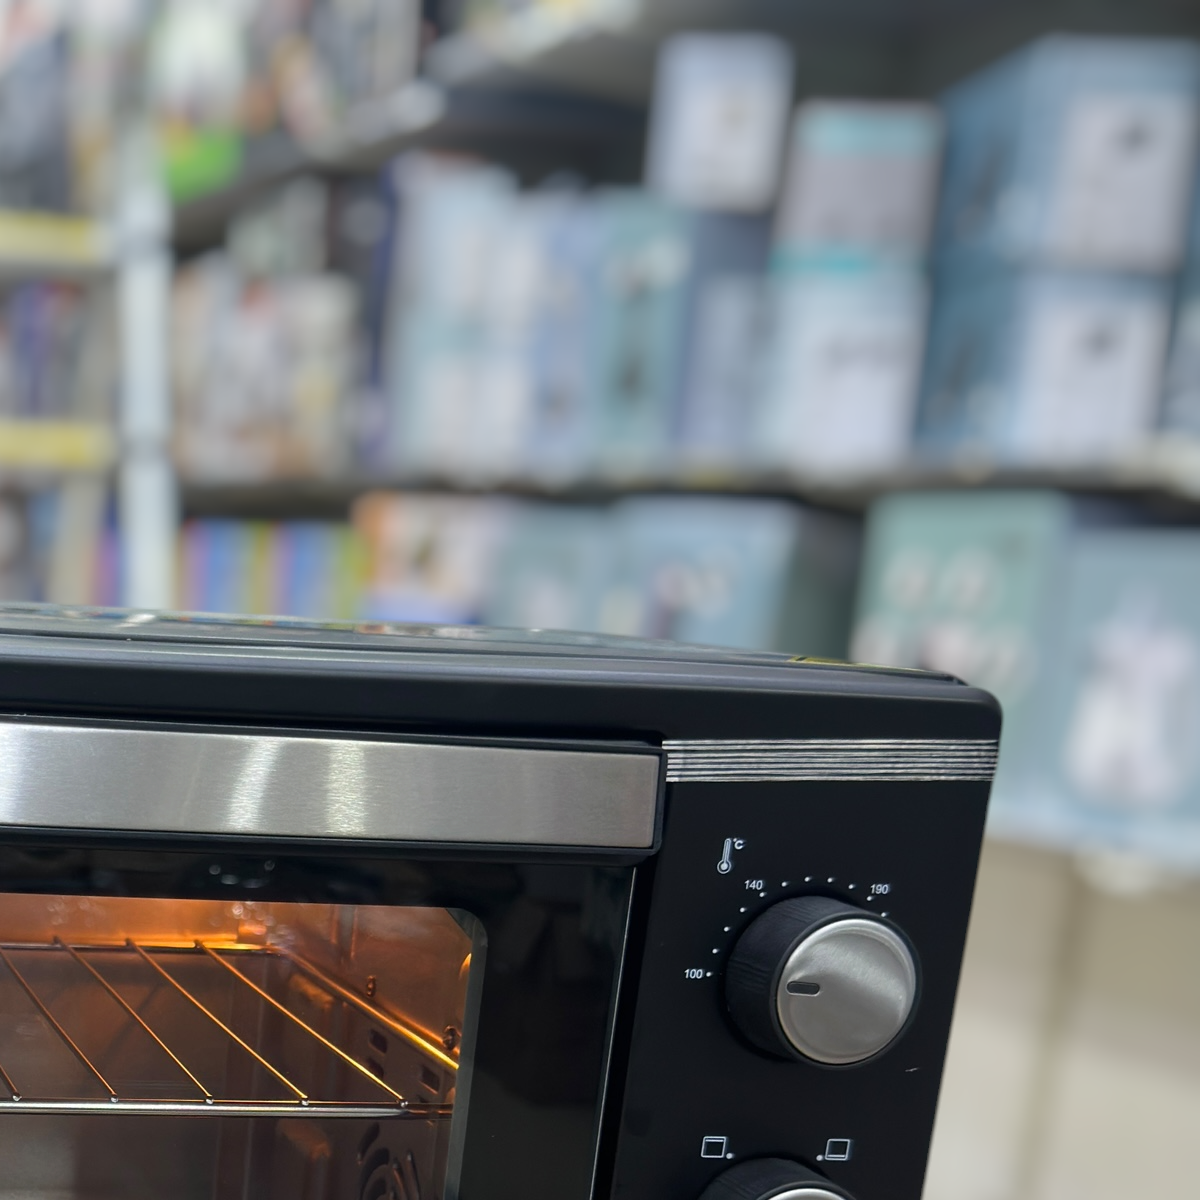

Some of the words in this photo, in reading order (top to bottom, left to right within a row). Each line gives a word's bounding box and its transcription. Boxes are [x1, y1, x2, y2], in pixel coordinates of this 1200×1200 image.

[744, 879, 763, 891] 140
[870, 883, 889, 895] 190
[684, 968, 703, 980] 100
